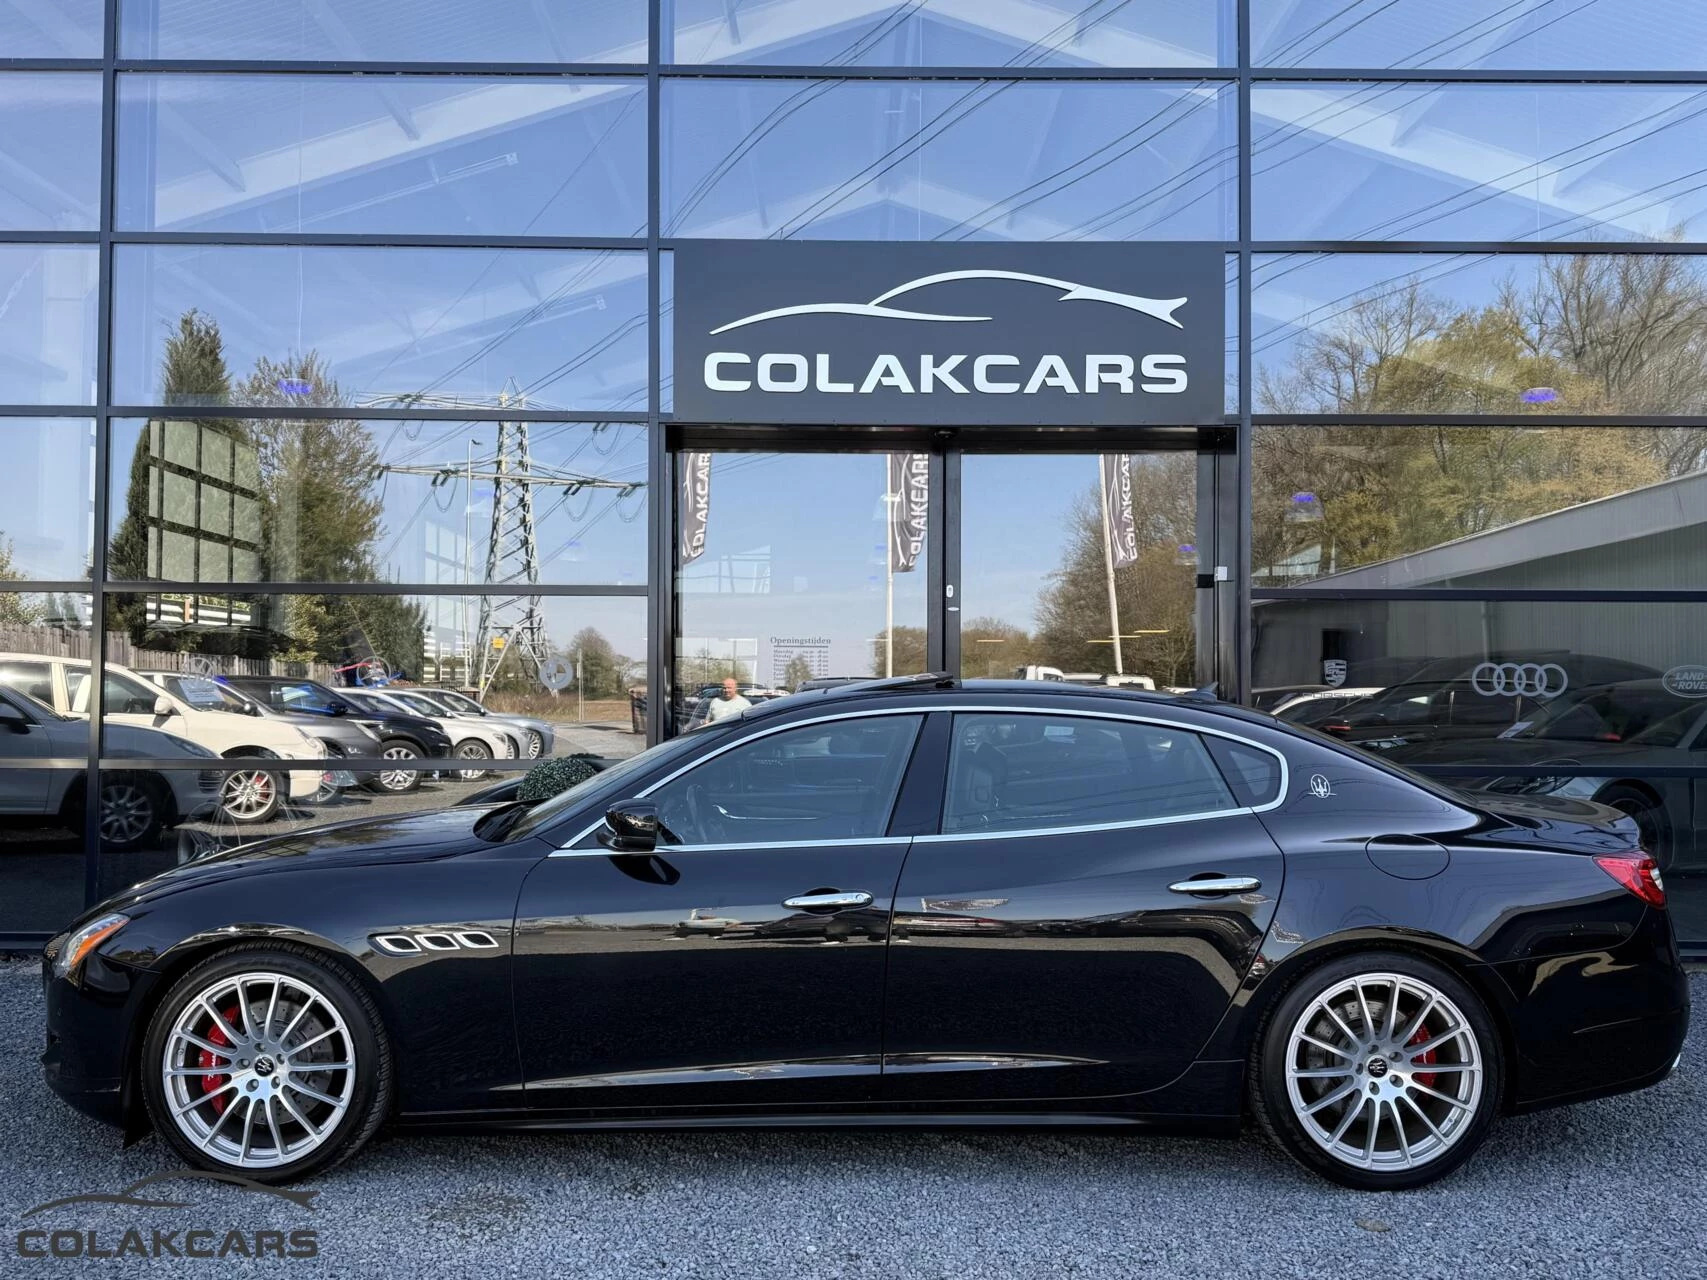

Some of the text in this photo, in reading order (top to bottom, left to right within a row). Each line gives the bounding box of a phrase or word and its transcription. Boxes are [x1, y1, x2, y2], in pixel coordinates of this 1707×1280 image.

[703, 351, 1188, 394] COLAKCARS
[770, 637, 831, 645] Openingstijden
[1675, 672, 1704, 680] LAND
